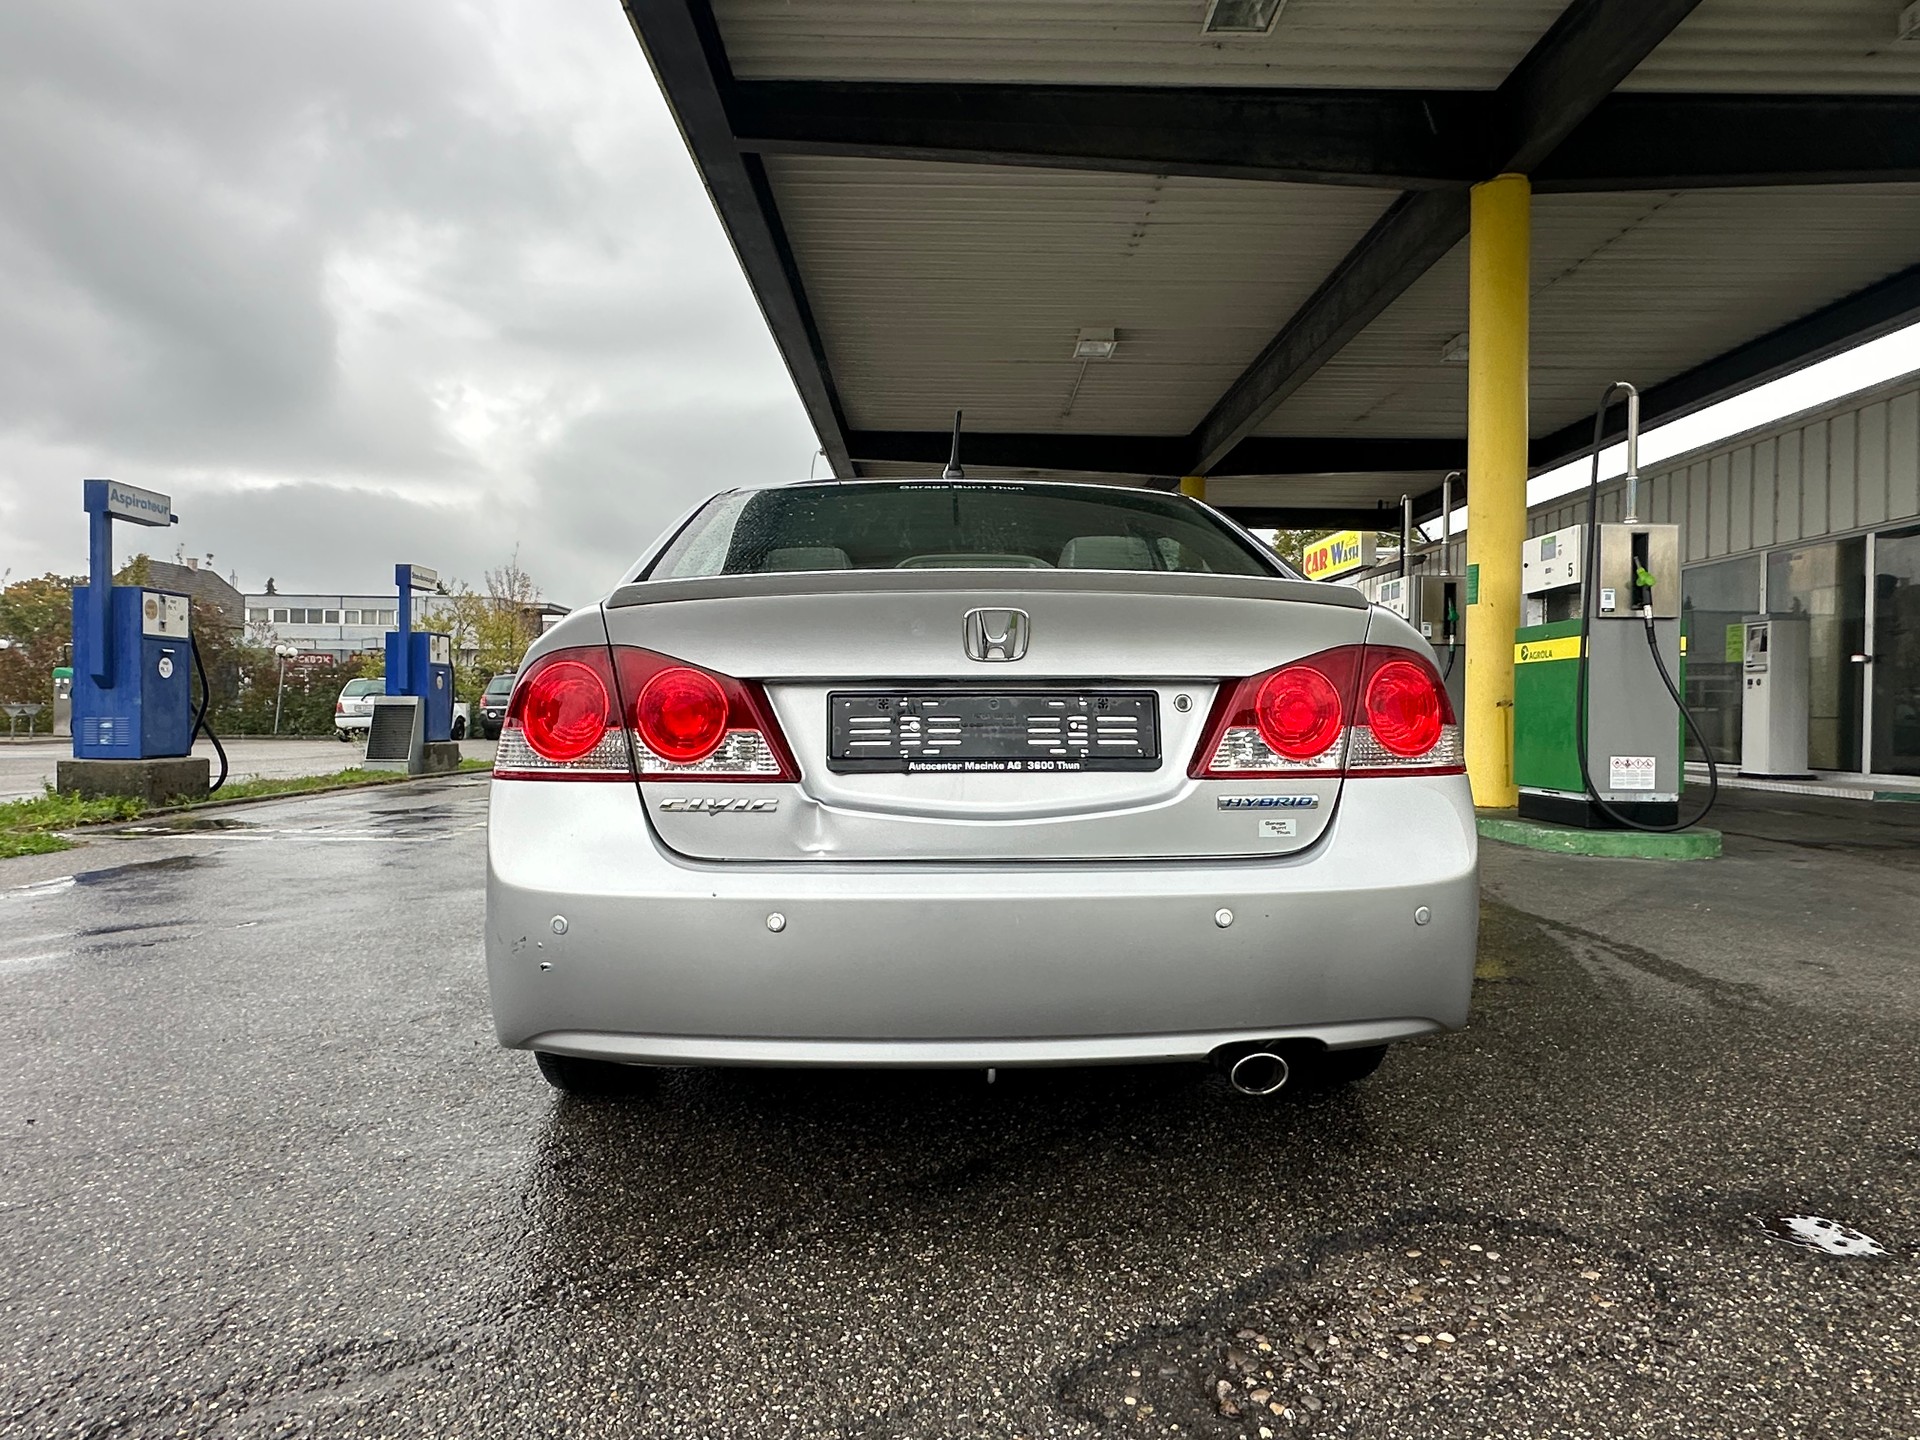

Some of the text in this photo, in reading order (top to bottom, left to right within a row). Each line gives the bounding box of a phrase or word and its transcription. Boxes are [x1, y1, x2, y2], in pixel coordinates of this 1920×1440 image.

[111, 488, 169, 515] Aspirateur
[1305, 547, 1328, 575] CAR
[1567, 562, 1574, 577] 5
[1529, 650, 1553, 660] AGROLA
[908, 762, 963, 771] Autocenter
[1007, 761, 1022, 770] AG
[1056, 761, 1080, 770] Thun
[659, 798, 779, 816] CIVIC
[1224, 796, 1314, 808] HYBRID
